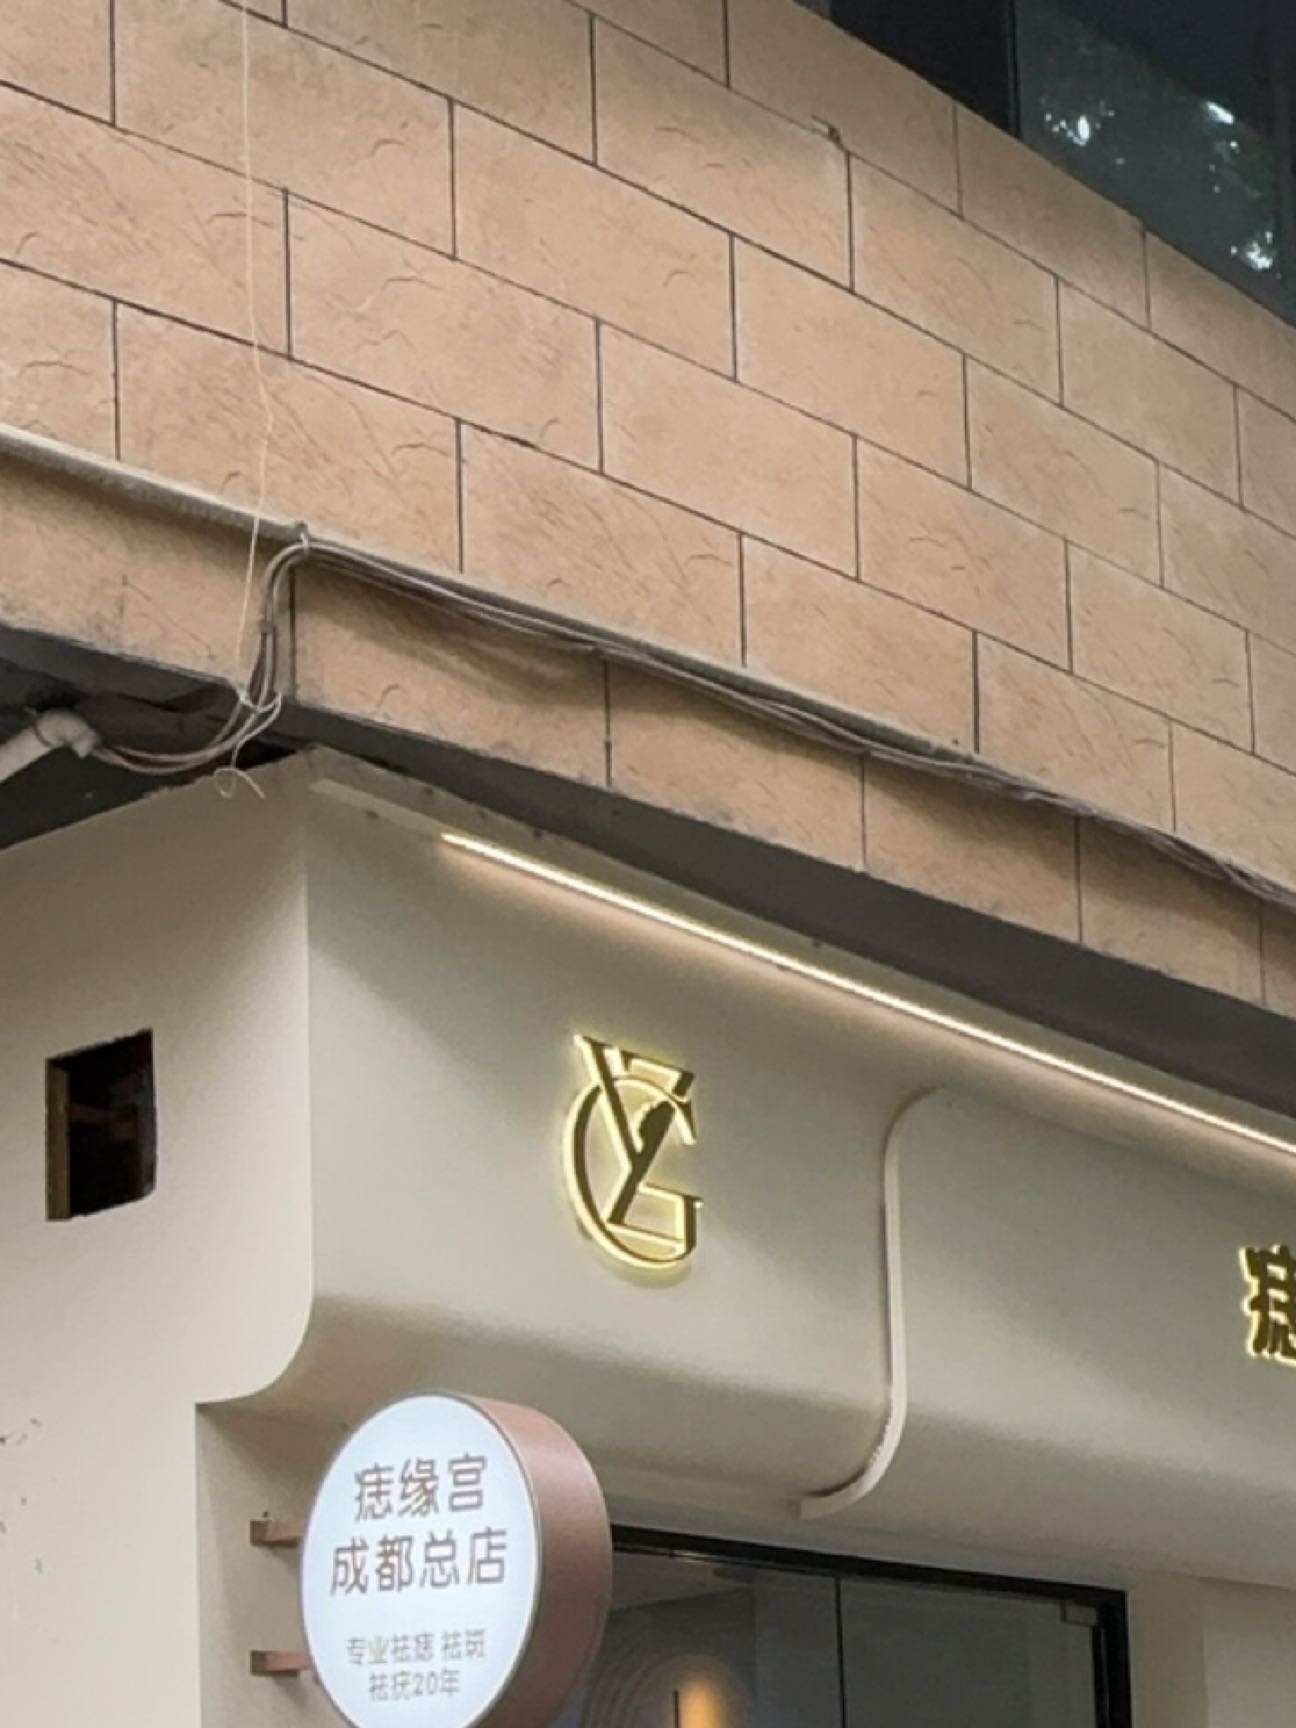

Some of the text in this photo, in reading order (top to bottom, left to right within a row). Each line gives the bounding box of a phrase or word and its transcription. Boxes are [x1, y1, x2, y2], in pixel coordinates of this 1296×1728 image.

[354, 1453, 487, 1522] 痣缘宫
[331, 1527, 507, 1596] 成都总店
